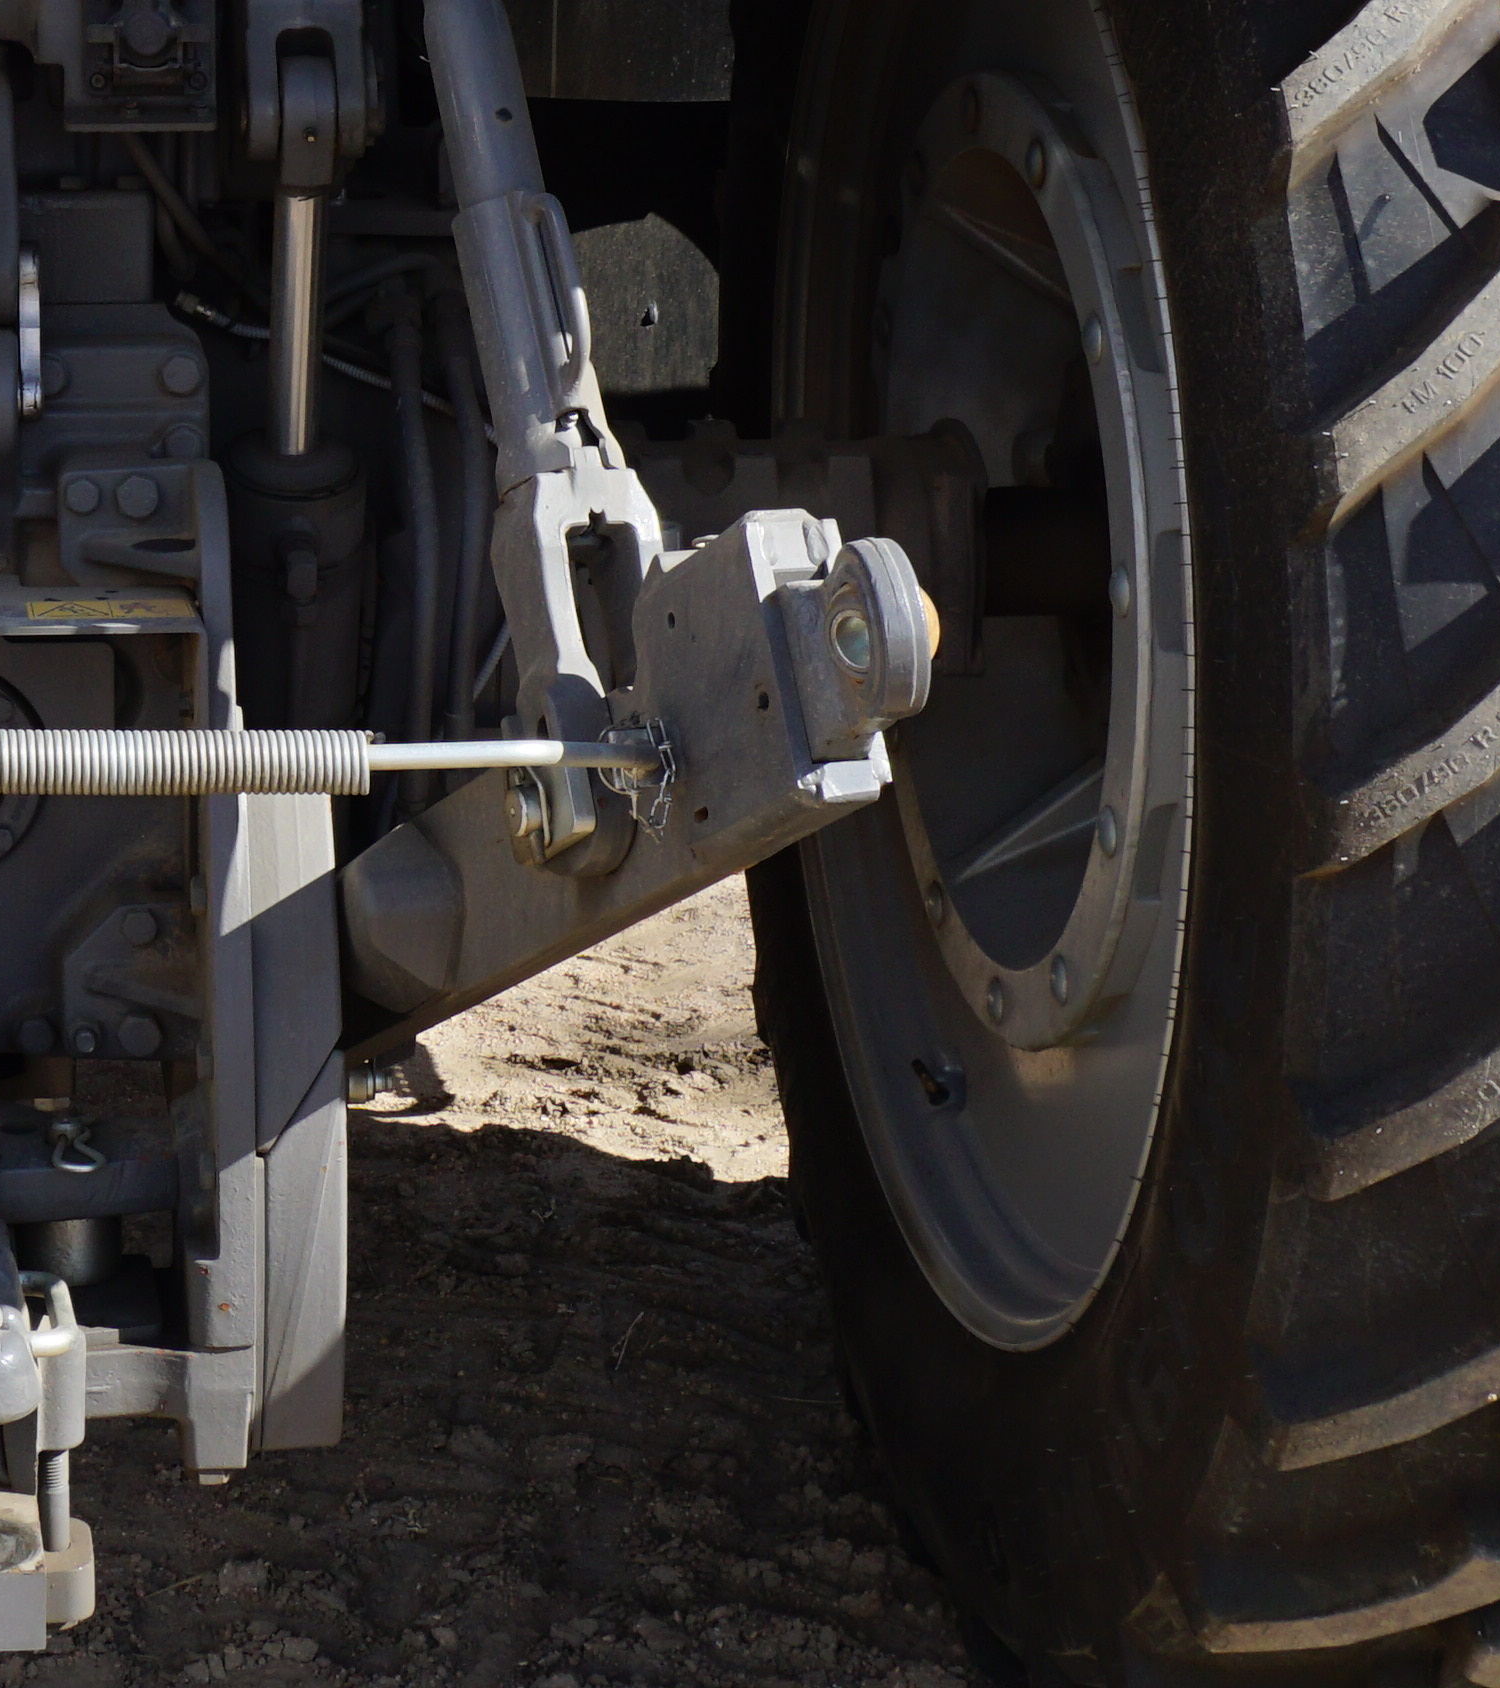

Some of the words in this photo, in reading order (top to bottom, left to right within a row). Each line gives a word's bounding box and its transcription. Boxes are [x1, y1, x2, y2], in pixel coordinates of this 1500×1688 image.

[1293, 29, 1388, 108] 380/90
[1435, 330, 1484, 380] 100
[1469, 724, 1498, 751] R
